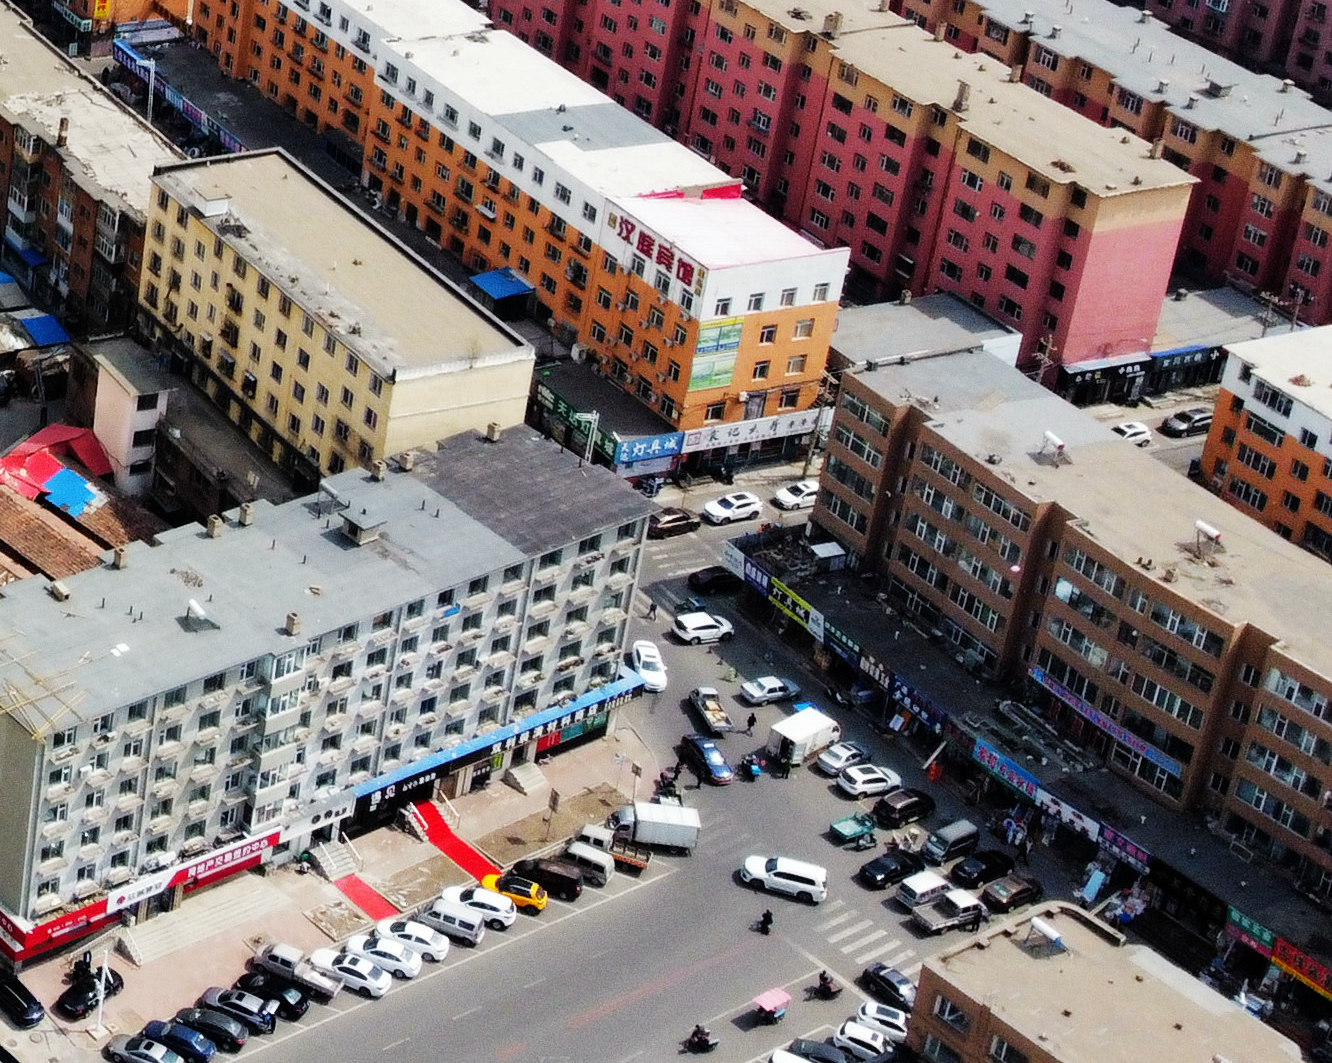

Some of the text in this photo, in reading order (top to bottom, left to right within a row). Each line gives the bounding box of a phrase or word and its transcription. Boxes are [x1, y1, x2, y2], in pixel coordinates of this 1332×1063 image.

[617, 215, 694, 286] 汉庭宾馆
[633, 437, 679, 457] 灯具城
